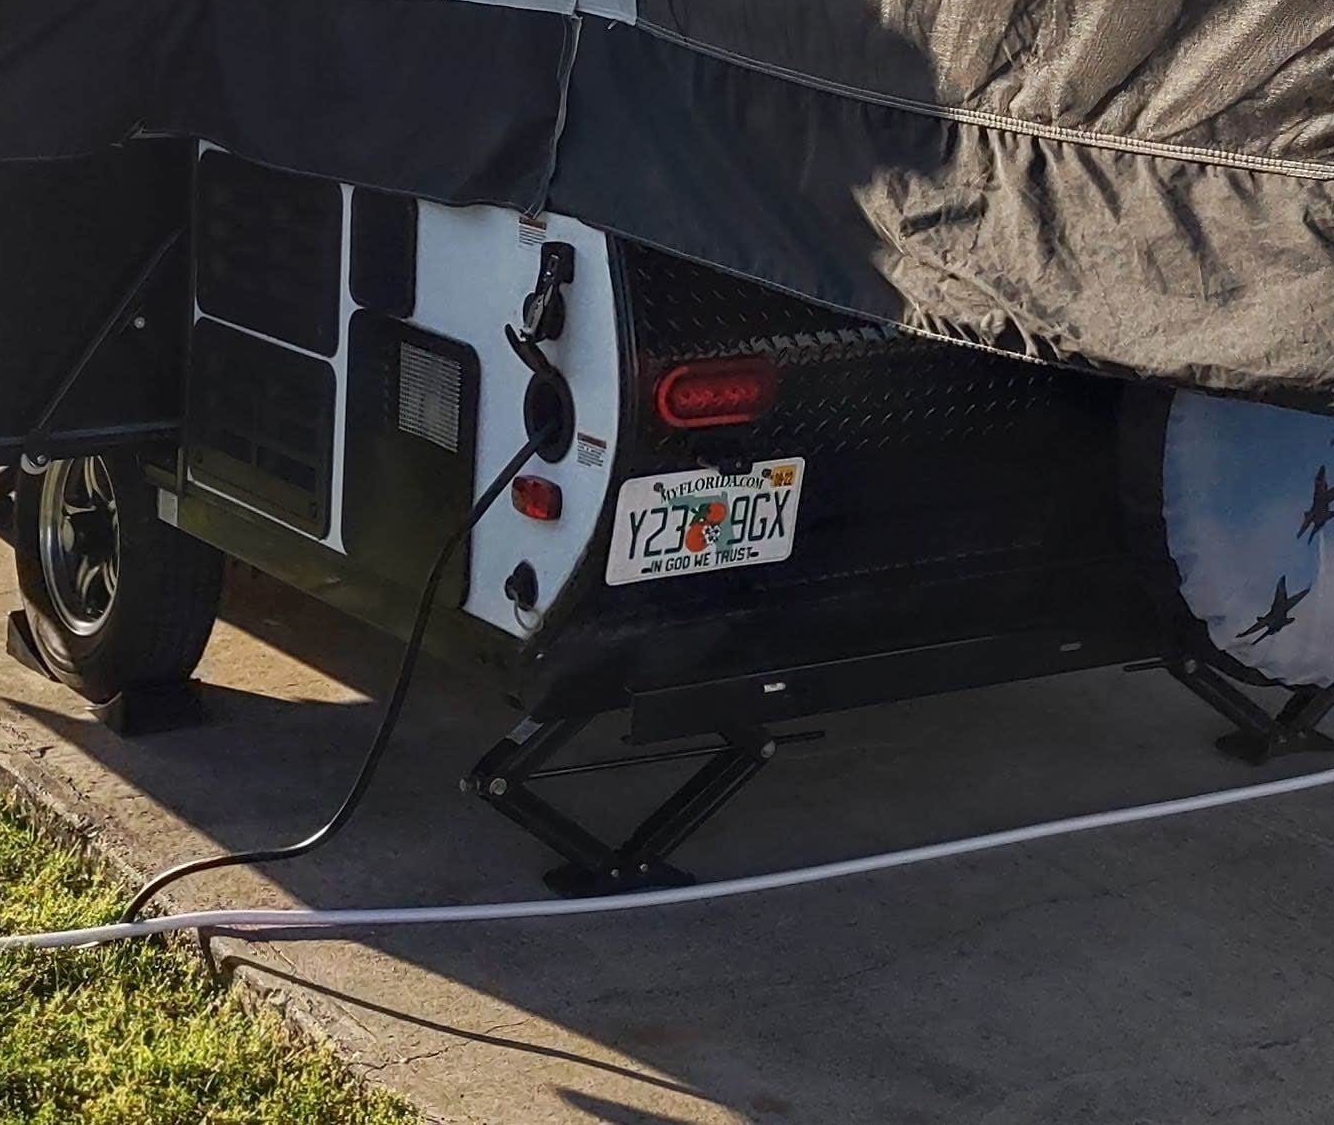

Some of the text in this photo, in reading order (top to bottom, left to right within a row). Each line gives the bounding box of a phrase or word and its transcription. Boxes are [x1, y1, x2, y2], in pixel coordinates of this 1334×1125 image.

[651, 547, 752, 572] IN GOD WE TRUST
